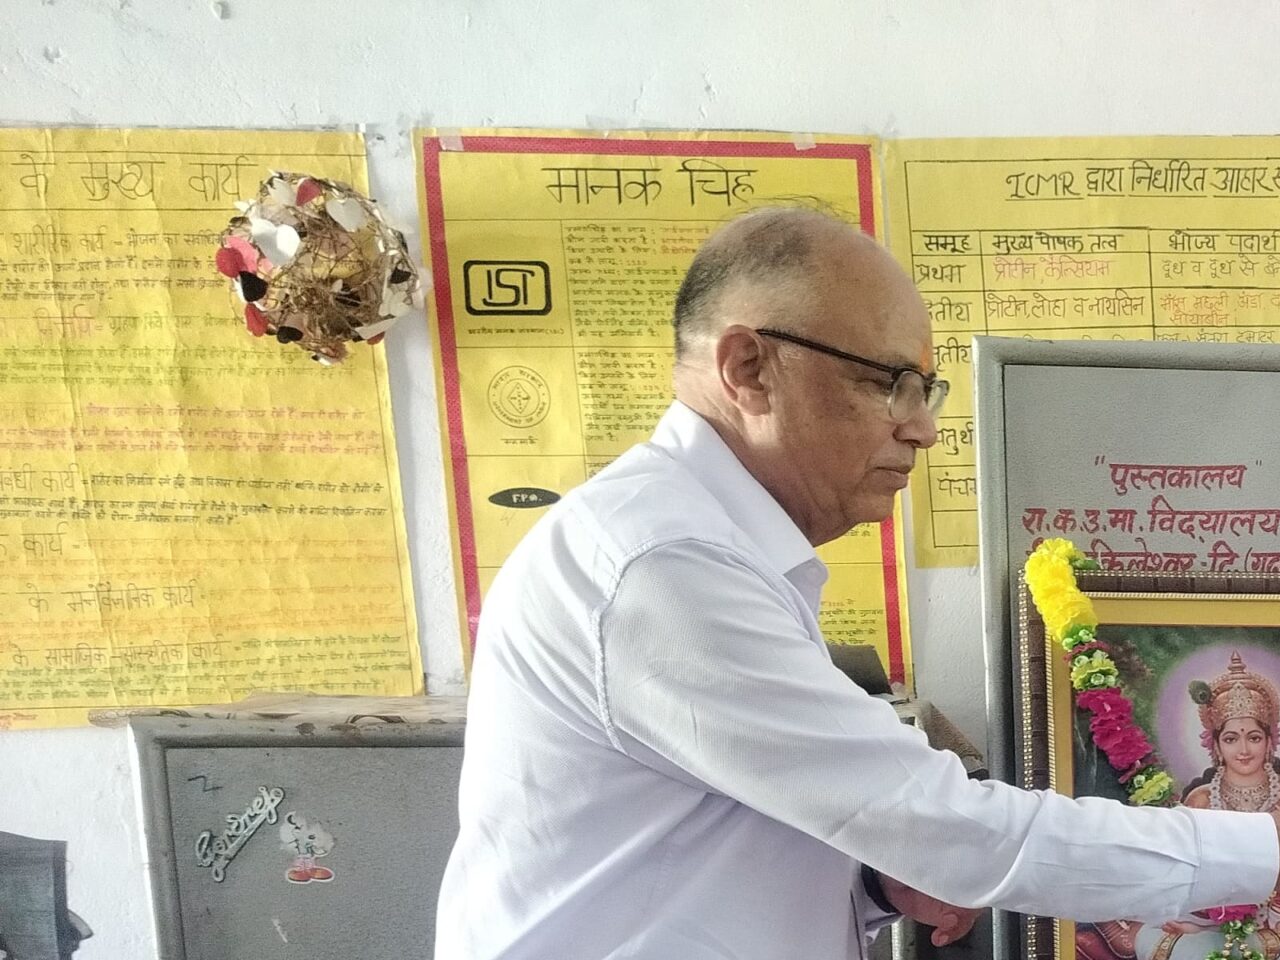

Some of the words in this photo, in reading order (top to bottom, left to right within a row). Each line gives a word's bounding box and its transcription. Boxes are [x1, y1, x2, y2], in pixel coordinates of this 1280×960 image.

[11, 153, 57, 198] के
[68, 161, 165, 200] मुख्य
[188, 155, 258, 201] कार्य
[541, 168, 662, 206] मानक
[1005, 171, 1081, 198] ICMR
[1086, 167, 1124, 194] द्वारा
[1128, 159, 1208, 193] निर्धारित
[1210, 167, 1274, 191] आहार
[923, 234, 972, 254] समूह
[992, 234, 1033, 255] मुख्य
[16, 582, 53, 612] के
[160, 579, 196, 608] कार्य
